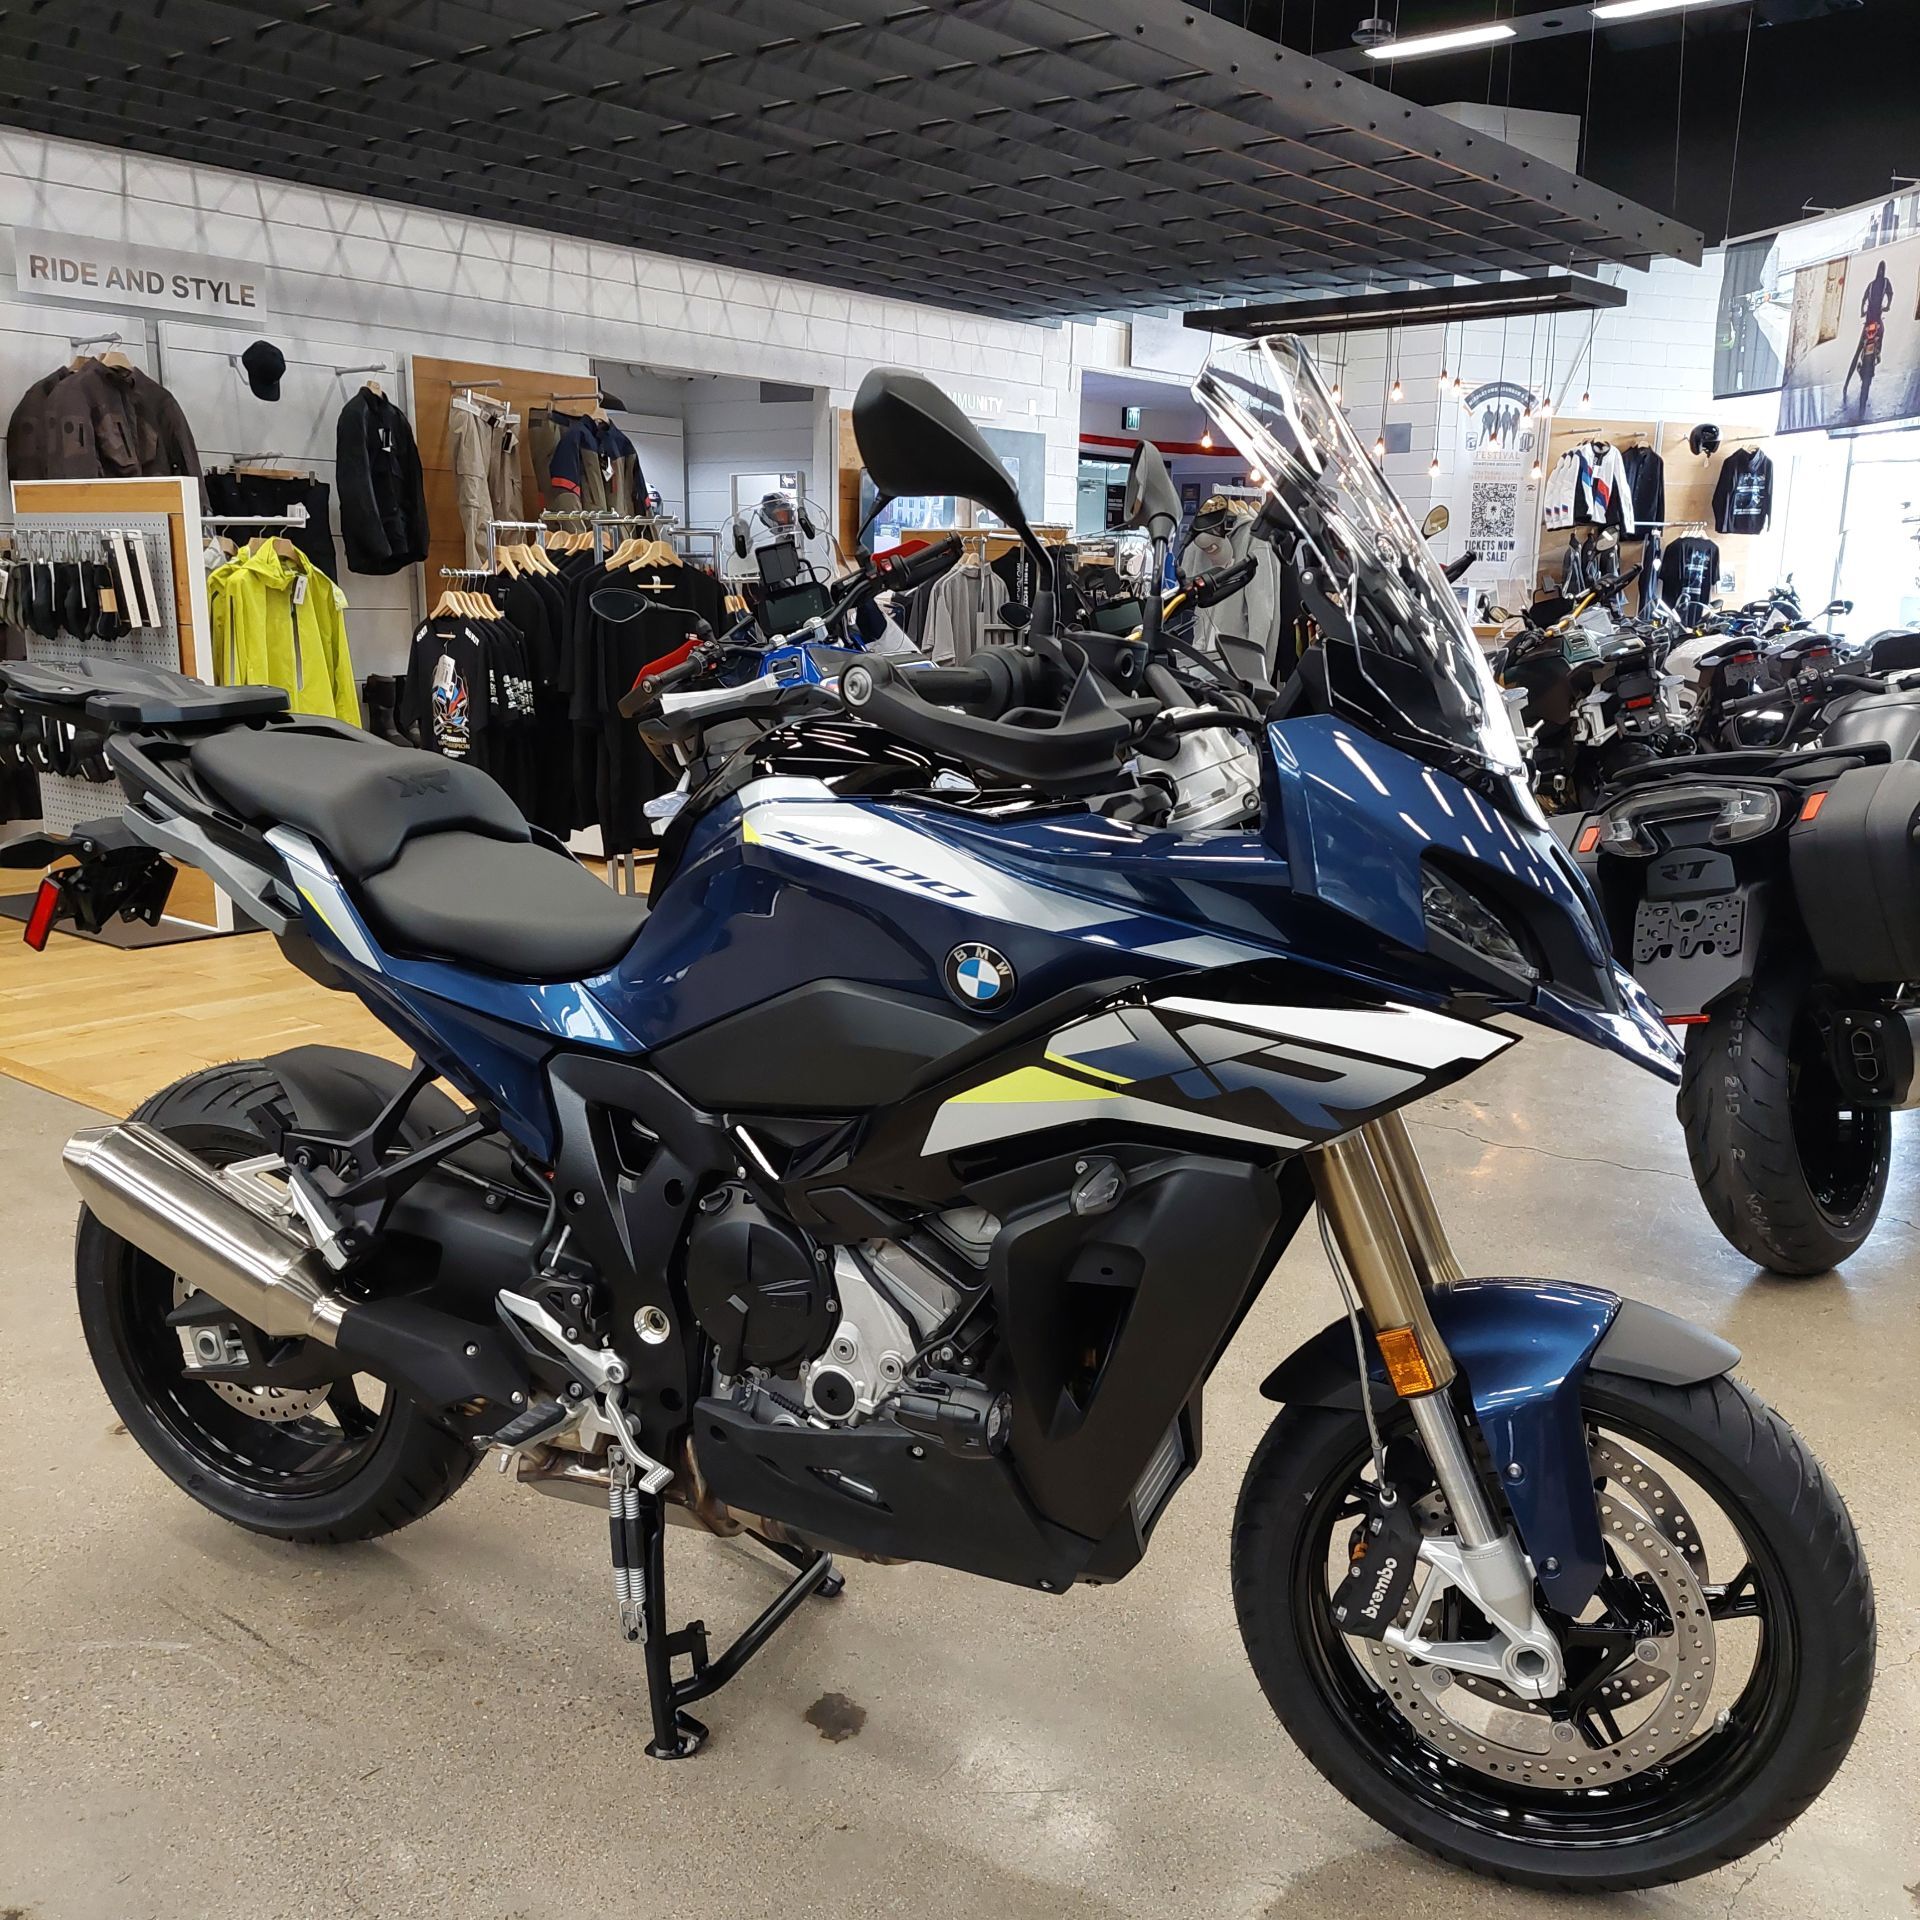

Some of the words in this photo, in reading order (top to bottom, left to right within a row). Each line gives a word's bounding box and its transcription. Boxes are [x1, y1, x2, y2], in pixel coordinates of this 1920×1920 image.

[29, 254, 99, 287] RIDE
[105, 266, 165, 295] AND
[171, 274, 256, 308] STYLE
[946, 390, 1004, 414] MMUNITY
[1475, 450, 1521, 461] FESTIVAL
[1464, 539, 1495, 551] TICKETS
[1497, 540, 1516, 551] NOW
[1486, 551, 1508, 562] SALE!
[953, 946, 1010, 976] BMW
[1361, 1557, 1398, 1620] brembo
